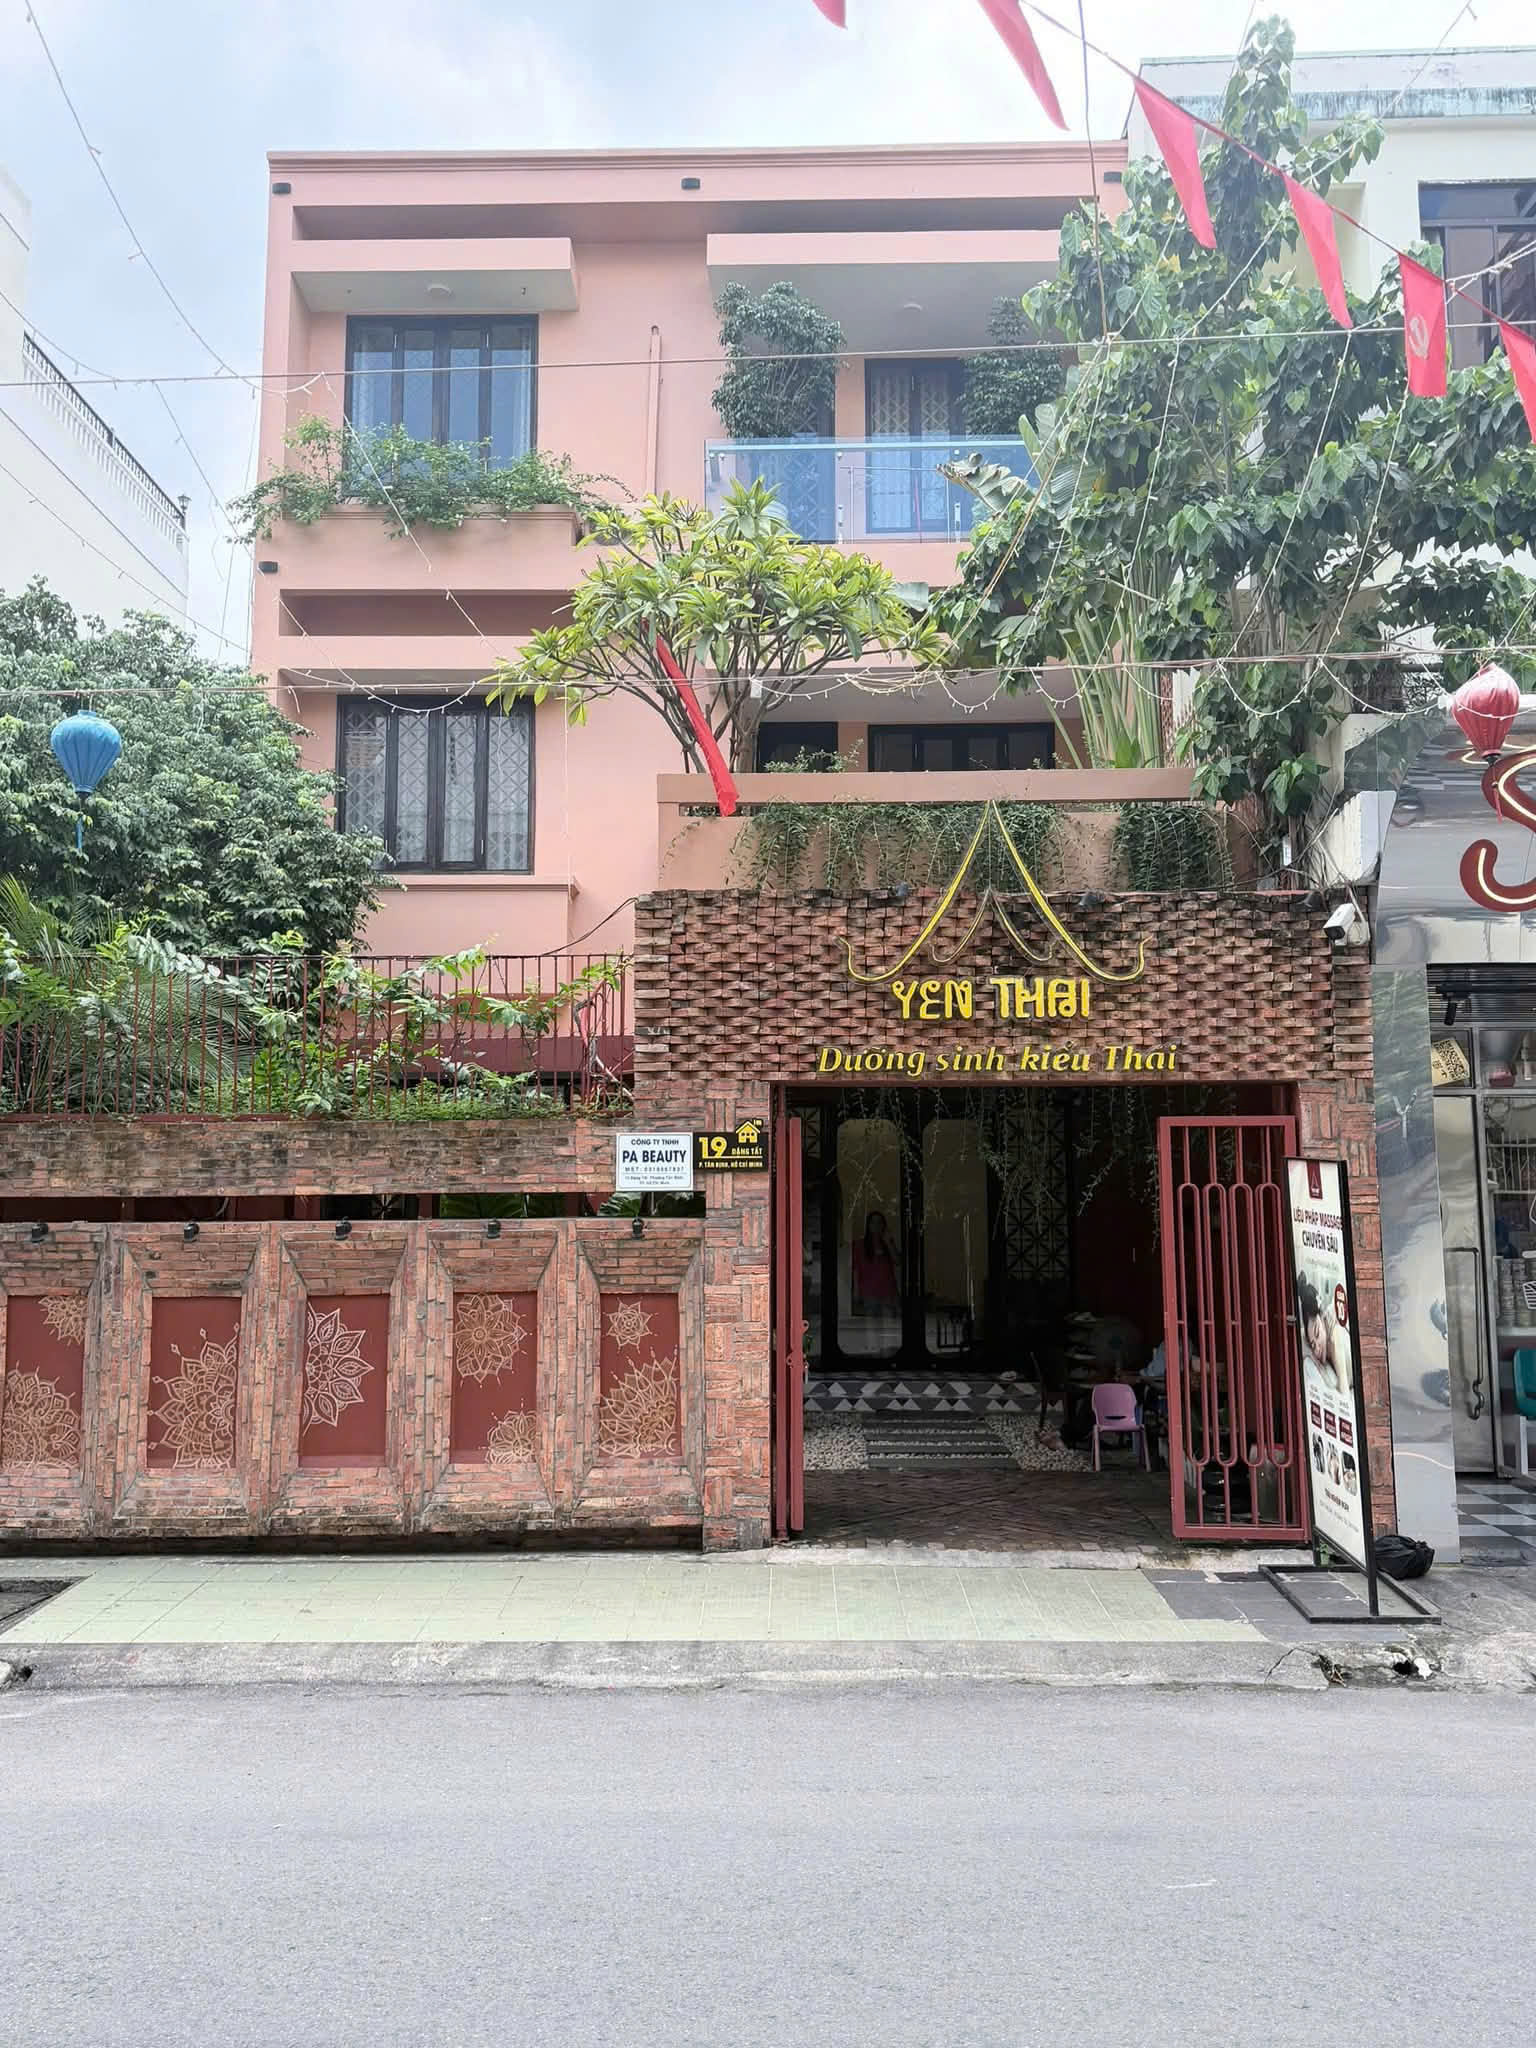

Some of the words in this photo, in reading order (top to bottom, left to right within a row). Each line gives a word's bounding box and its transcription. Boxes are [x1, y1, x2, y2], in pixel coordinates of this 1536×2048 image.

[891, 979, 974, 1019] YEN
[989, 977, 1091, 1018] THAI
[935, 1046, 1006, 1071] sinh
[631, 1138, 652, 1146] CÔNG
[698, 1136, 728, 1159] 19
[622, 1150, 638, 1163] PA
[642, 1150, 687, 1163] BEAUTY
